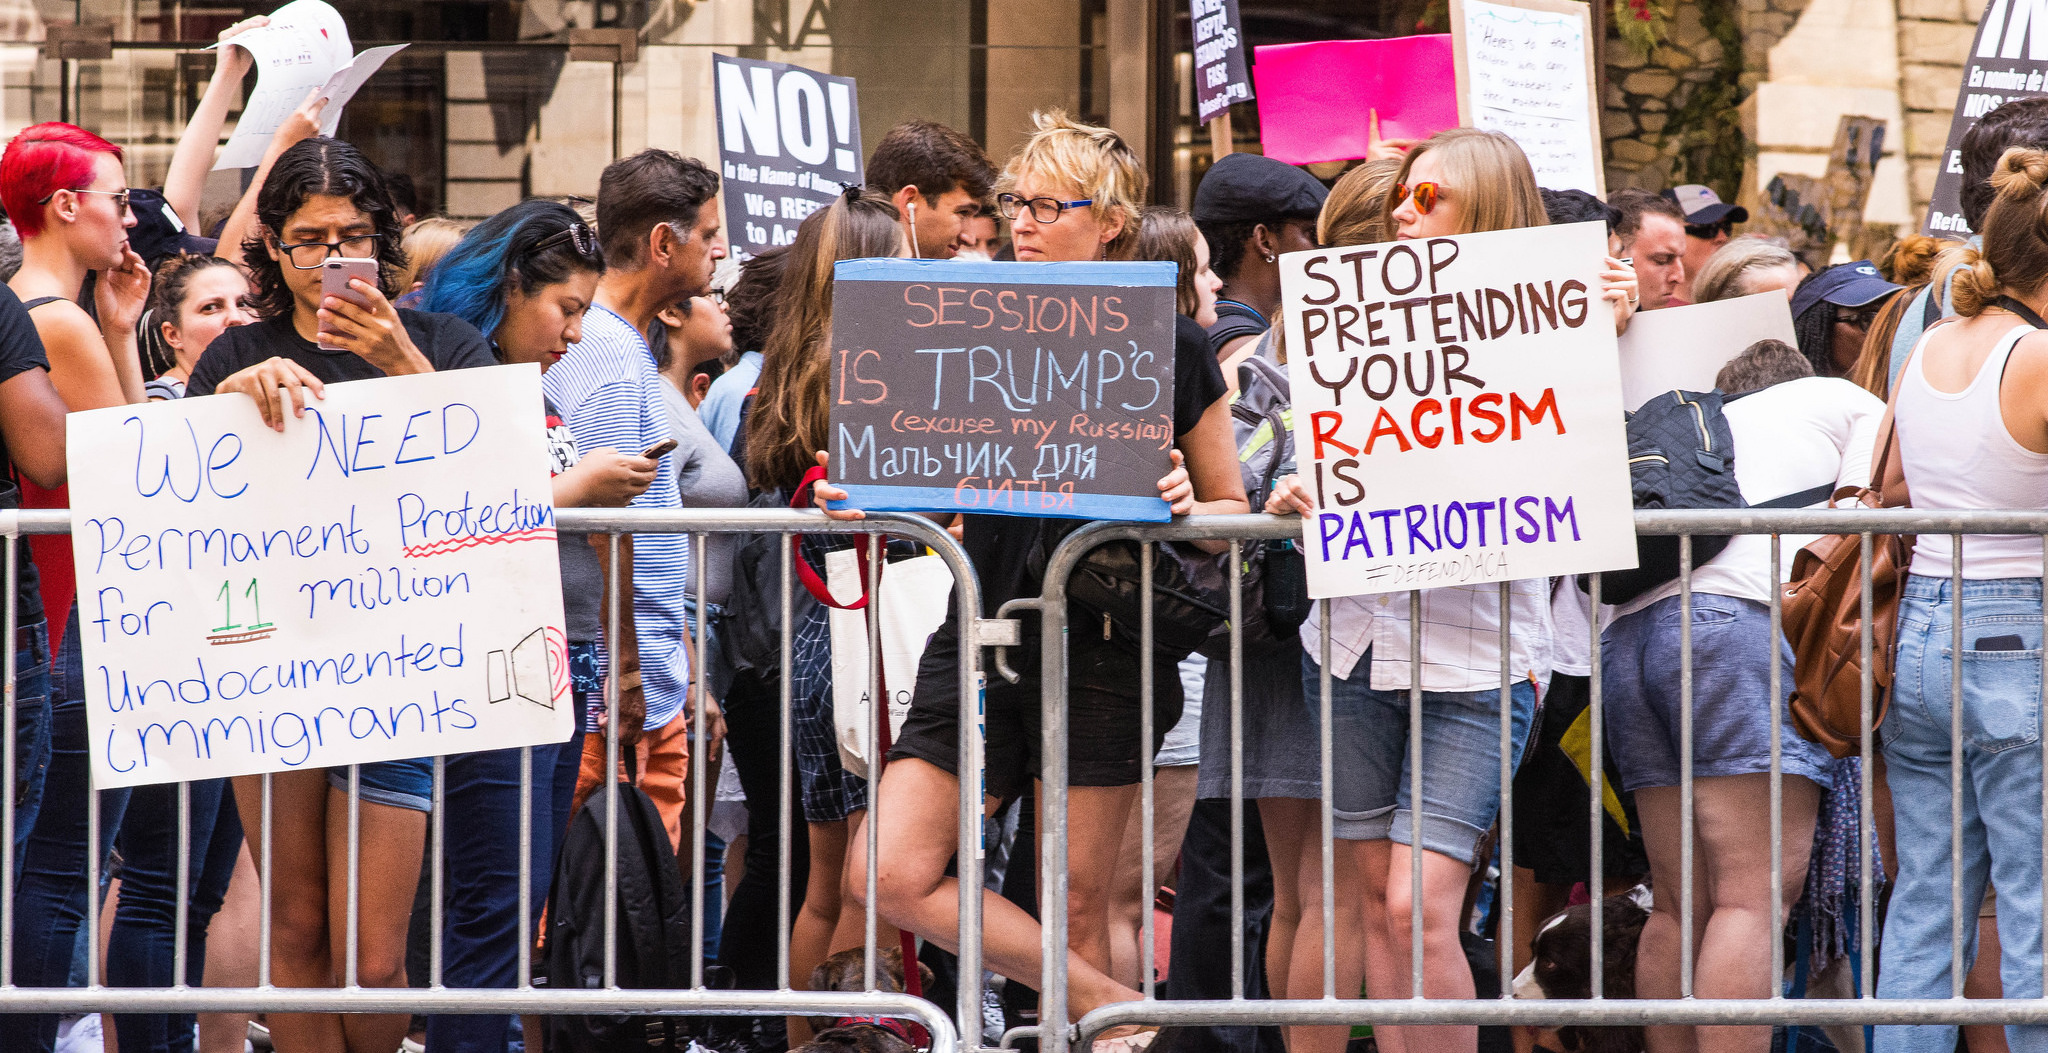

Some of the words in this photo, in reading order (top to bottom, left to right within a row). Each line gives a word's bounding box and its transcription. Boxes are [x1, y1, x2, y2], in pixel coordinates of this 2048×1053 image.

[2025, 69, 2043, 92] de
[718, 61, 856, 173] NO!
[724, 160, 736, 179] In
[737, 163, 758, 183] the
[760, 166, 797, 186] Name
[798, 171, 811, 189] of
[744, 193, 777, 218] We
[746, 221, 768, 245] to
[1302, 238, 1459, 306] STOP
[904, 284, 1130, 337] SESSIONS
[1302, 279, 1588, 357] PRETENDING
[837, 350, 888, 405] IS
[915, 340, 1160, 412] TRUMP'S
[1309, 345, 1486, 406] YOUR
[123, 416, 249, 503] We
[303, 402, 480, 480] NEED
[891, 409, 1001, 434] (excuse
[1011, 416, 1058, 450] my
[1069, 413, 1174, 450] Russian)
[1310, 388, 1567, 459] RACISM
[1314, 458, 1366, 510] IS
[84, 504, 370, 574] Permanent
[398, 488, 555, 546] Protection
[1318, 495, 1581, 562] PATRIOTISM
[210, 577, 274, 632] 11
[299, 567, 470, 619] million
[107, 690, 478, 774] immigrants
